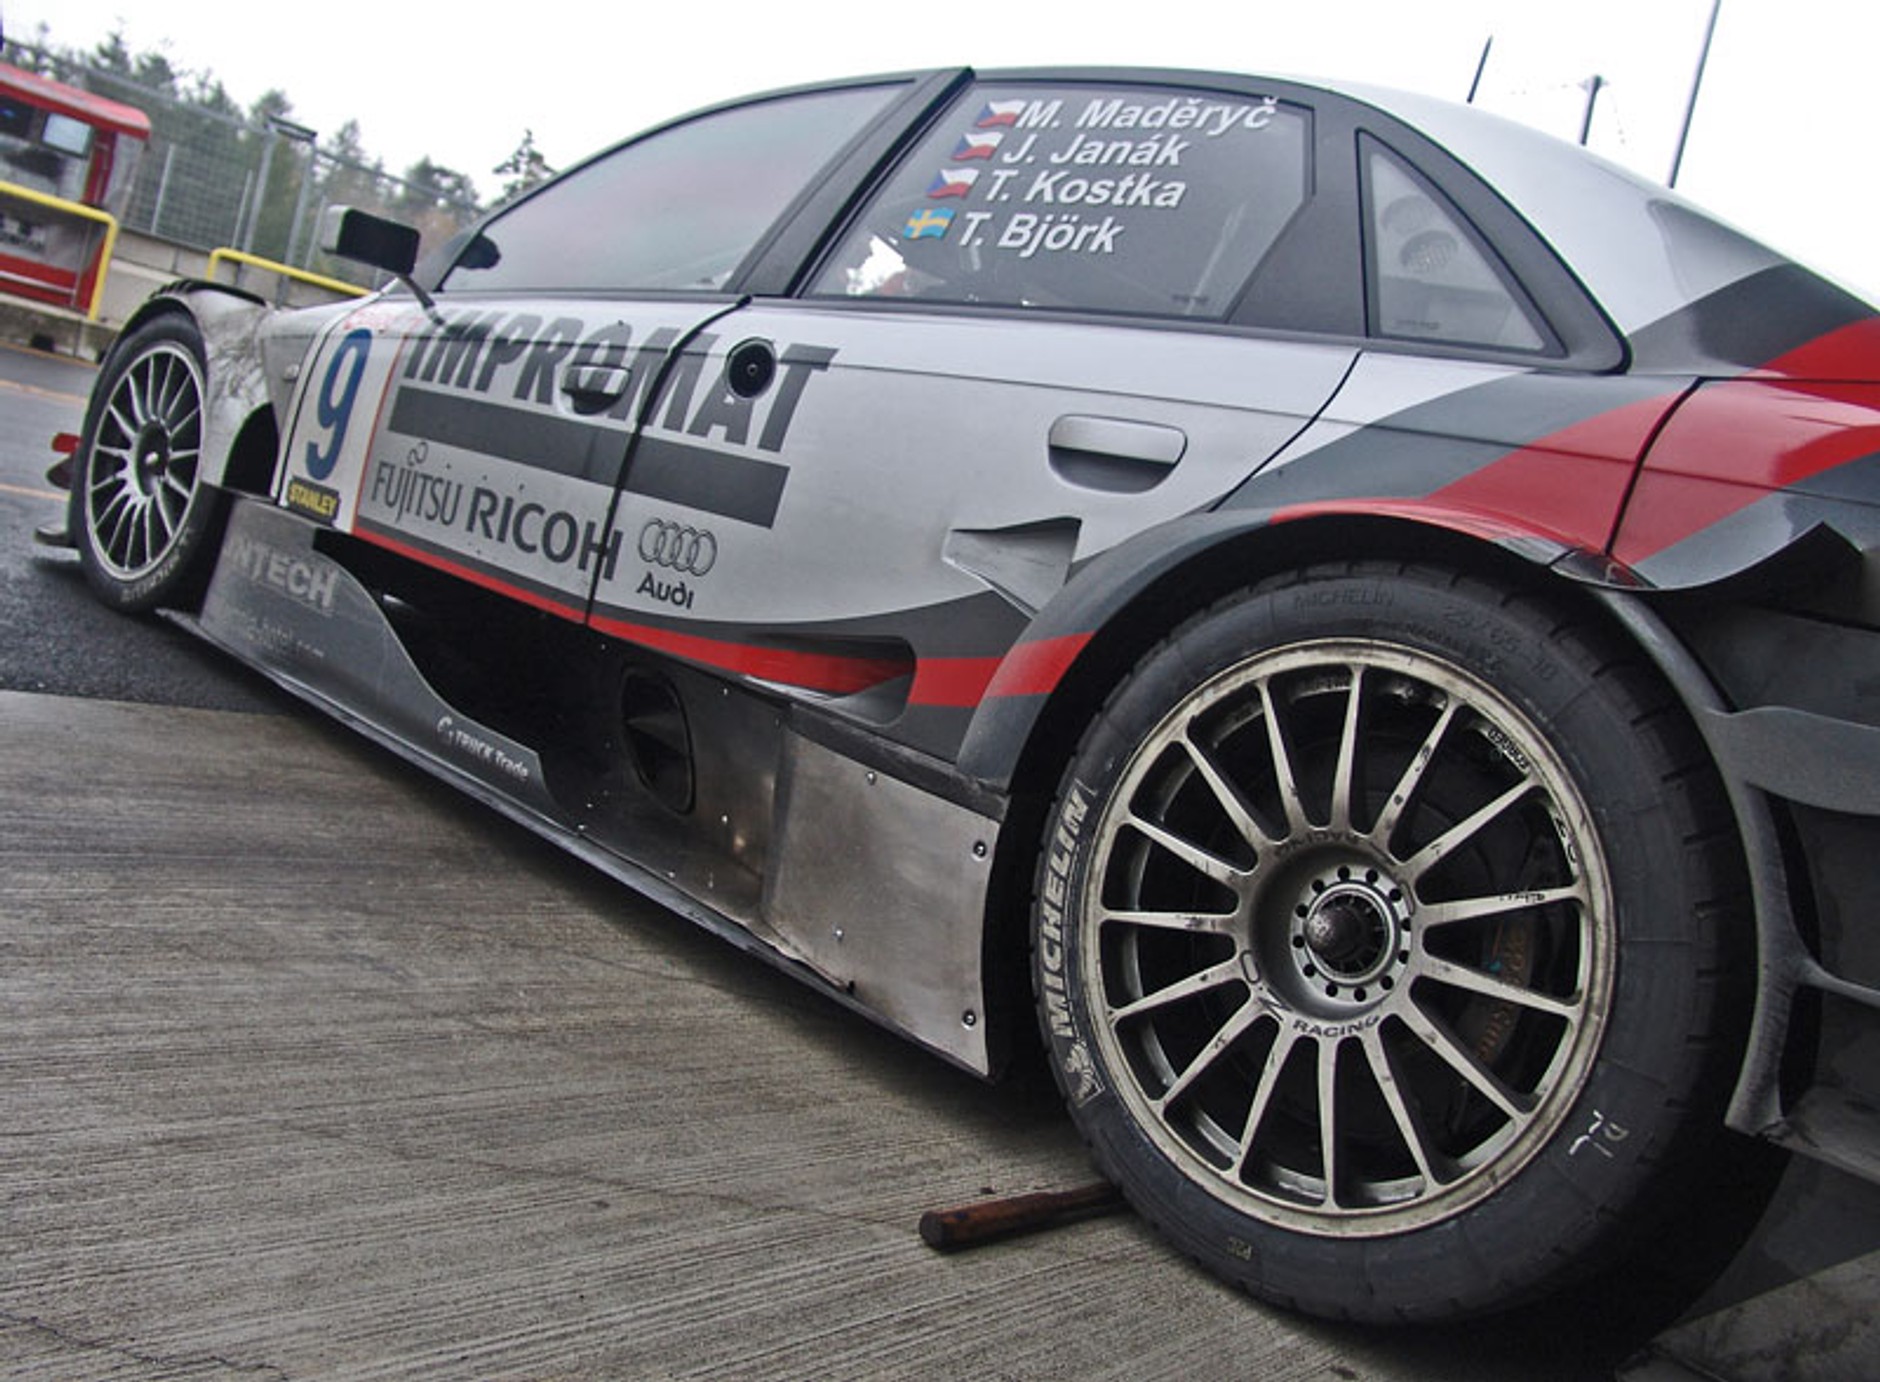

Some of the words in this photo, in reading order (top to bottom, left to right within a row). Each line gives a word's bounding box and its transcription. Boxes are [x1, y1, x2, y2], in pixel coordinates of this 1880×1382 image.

[1014, 99, 1063, 129] M.
[1075, 96, 1279, 136] Maděryč
[1002, 133, 1038, 164] J.
[1050, 133, 1190, 166] Janák
[986, 169, 1019, 201] T.
[1024, 169, 1187, 208] Kostka
[959, 212, 993, 246] T.
[998, 212, 1125, 258] Björk
[402, 309, 839, 453] IMPROMAT
[304, 328, 373, 481] 9
[371, 460, 463, 526] FUJITSU
[465, 487, 625, 582] RICOH
[636, 571, 695, 611] Audi
[1042, 788, 1089, 1039] MICHELIN
[1292, 1012, 1380, 1038] RACING
